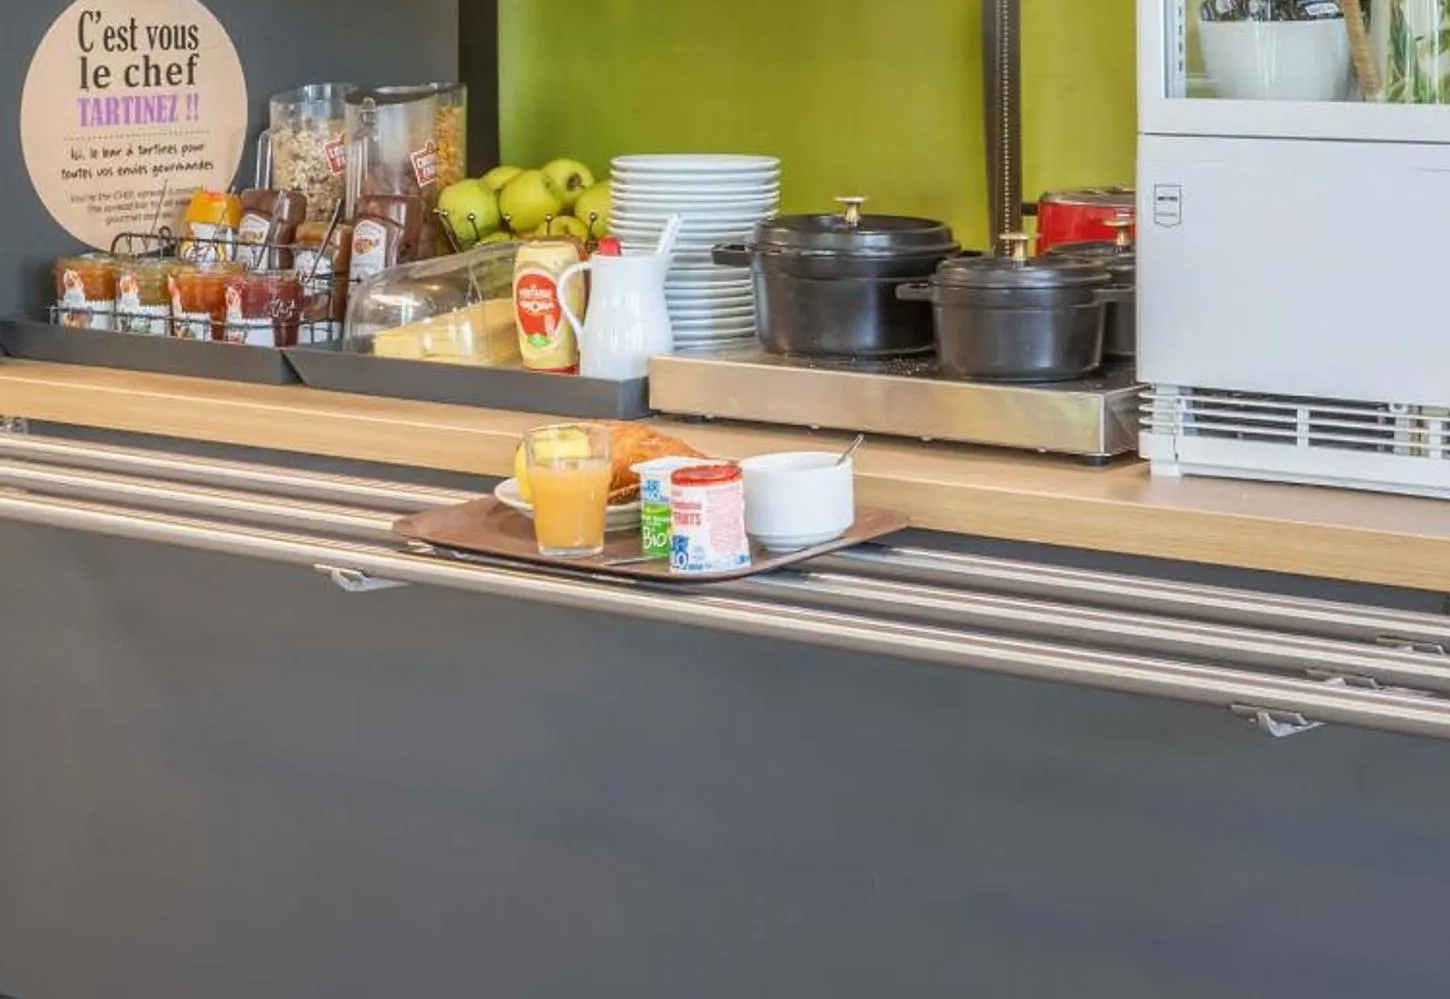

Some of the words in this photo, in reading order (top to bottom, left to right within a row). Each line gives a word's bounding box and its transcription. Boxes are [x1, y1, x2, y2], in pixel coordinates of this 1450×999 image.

[78, 10, 137, 53] C'est
[146, 23, 200, 51] vous
[79, 56, 111, 90] le
[124, 53, 200, 88] chef
[77, 94, 179, 127] TARTINEZ
[102, 147, 122, 159] bar
[138, 142, 178, 156] tartines
[181, 143, 206, 157] pour
[61, 168, 93, 180] toutes
[97, 167, 114, 177] vos
[117, 165, 148, 176] envies
